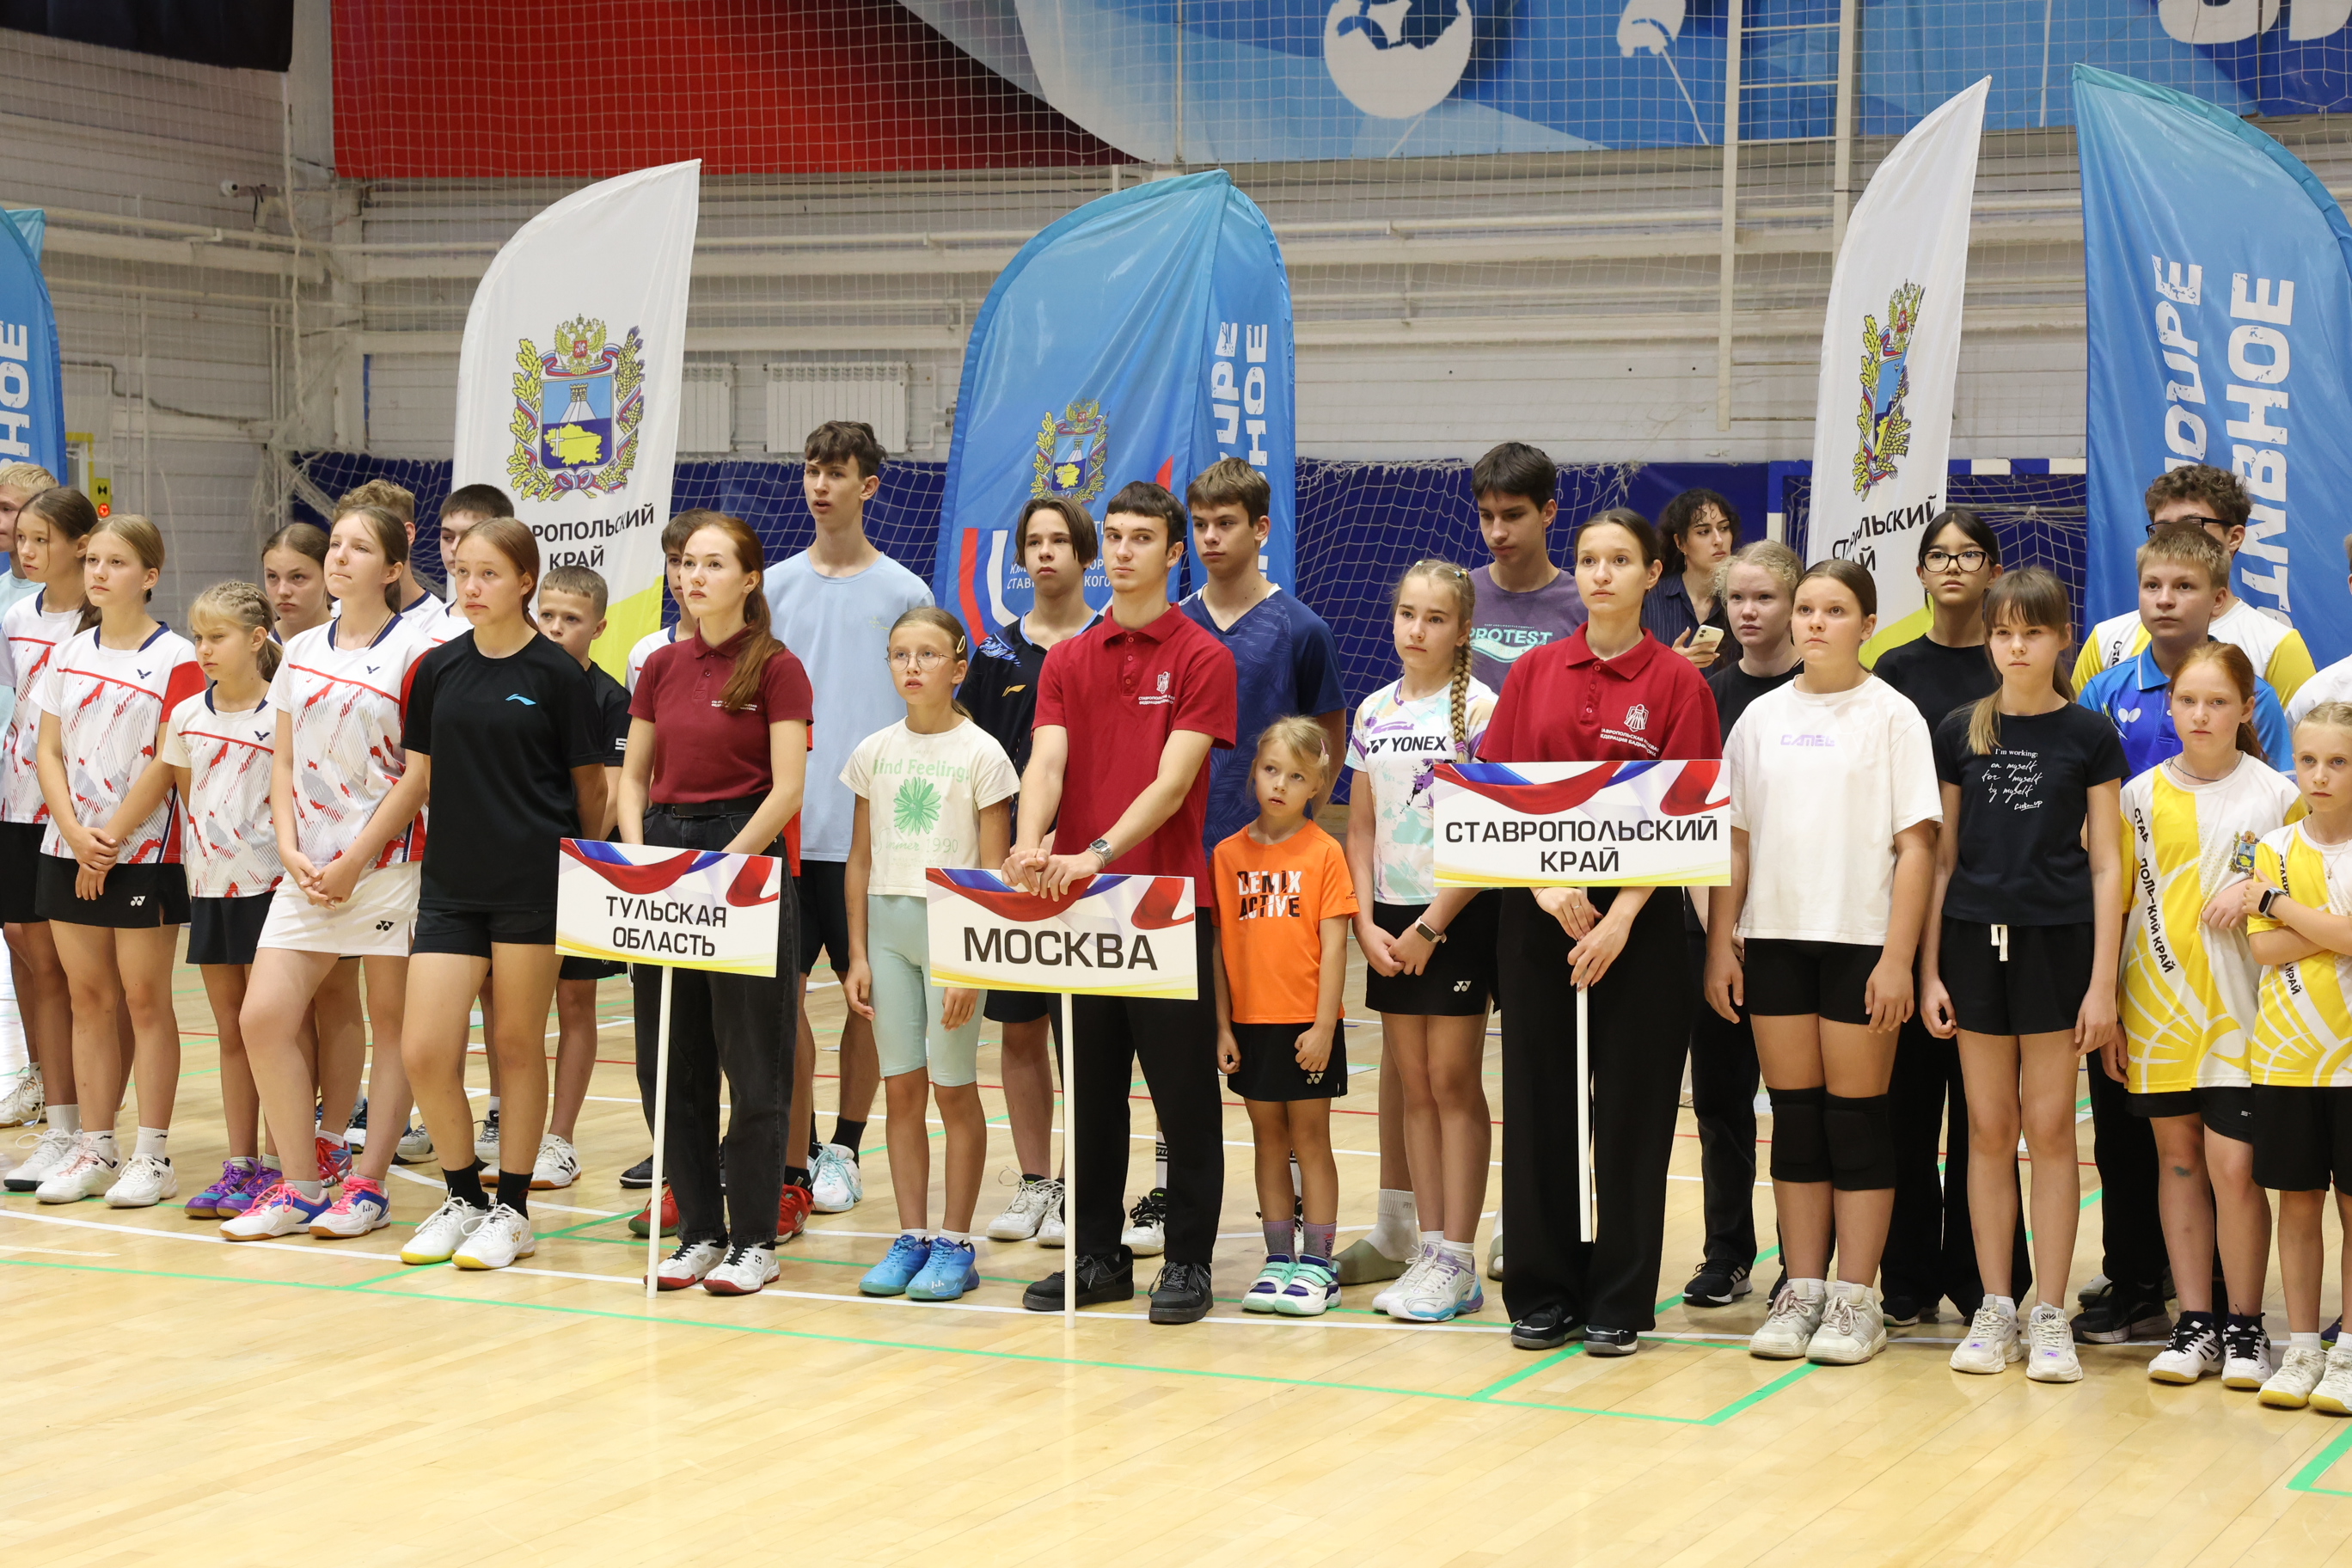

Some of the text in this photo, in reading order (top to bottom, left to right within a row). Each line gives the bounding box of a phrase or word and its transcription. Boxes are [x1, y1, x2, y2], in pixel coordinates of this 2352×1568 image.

[532, 503, 654, 542] РОПОЛЬСКИЙ
[549, 545, 604, 571] КРАЙ
[1469, 628, 1553, 646] PROTEST
[1391, 736, 1447, 752] YONEX
[1602, 728, 1644, 742] АВРОПОЛЬСКАЯ
[2008, 749, 2039, 759] working:
[1981, 769, 2043, 792] for myself
[2006, 760, 2038, 779] myself
[1988, 782, 2034, 804] by myself
[1445, 816, 1718, 843] СТАВРОПОЛЬСКИЙ
[1540, 848, 1620, 873] КРАЙ
[1237, 870, 1302, 896] DEMIX
[606, 896, 727, 928] ТУЛЬСКАЯ
[1238, 895, 1301, 921] ACTIVE
[613, 927, 716, 957] ОБЛАСТЬ
[964, 927, 1158, 971] МОСКВА
[2153, 935, 2177, 974] КРАЙ
[2285, 965, 2302, 995] КРАЙ
